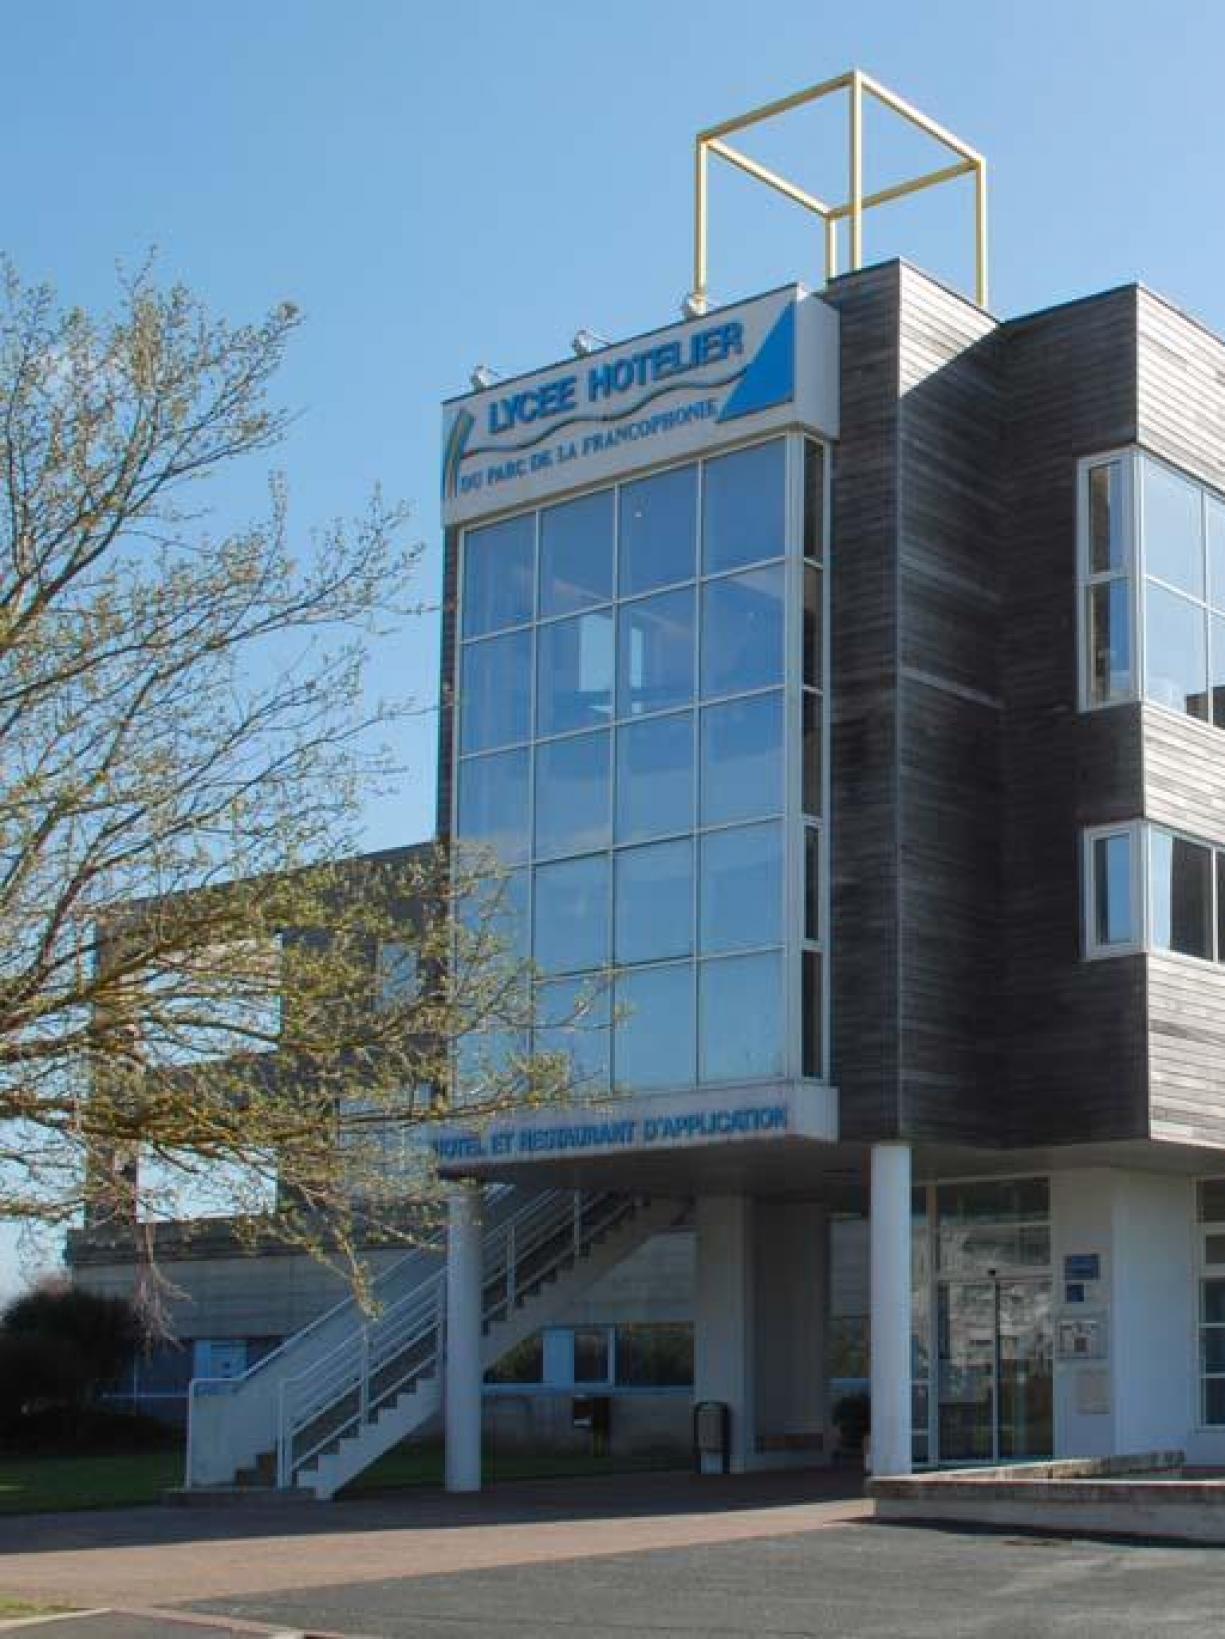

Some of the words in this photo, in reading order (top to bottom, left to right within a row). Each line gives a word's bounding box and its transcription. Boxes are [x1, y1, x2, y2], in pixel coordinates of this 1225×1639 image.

[488, 375, 577, 434] LYCEE
[588, 322, 744, 402] HOTELIER
[461, 473, 483, 493] DU
[487, 460, 529, 486] PARC
[530, 449, 555, 473] DE
[557, 441, 577, 463] LA
[582, 400, 716, 456] FRANCOPHONIE
[491, 1132, 514, 1155] ET
[519, 1120, 635, 1153] RESTAURANT
[643, 1104, 788, 1142] D'APPLICATION
